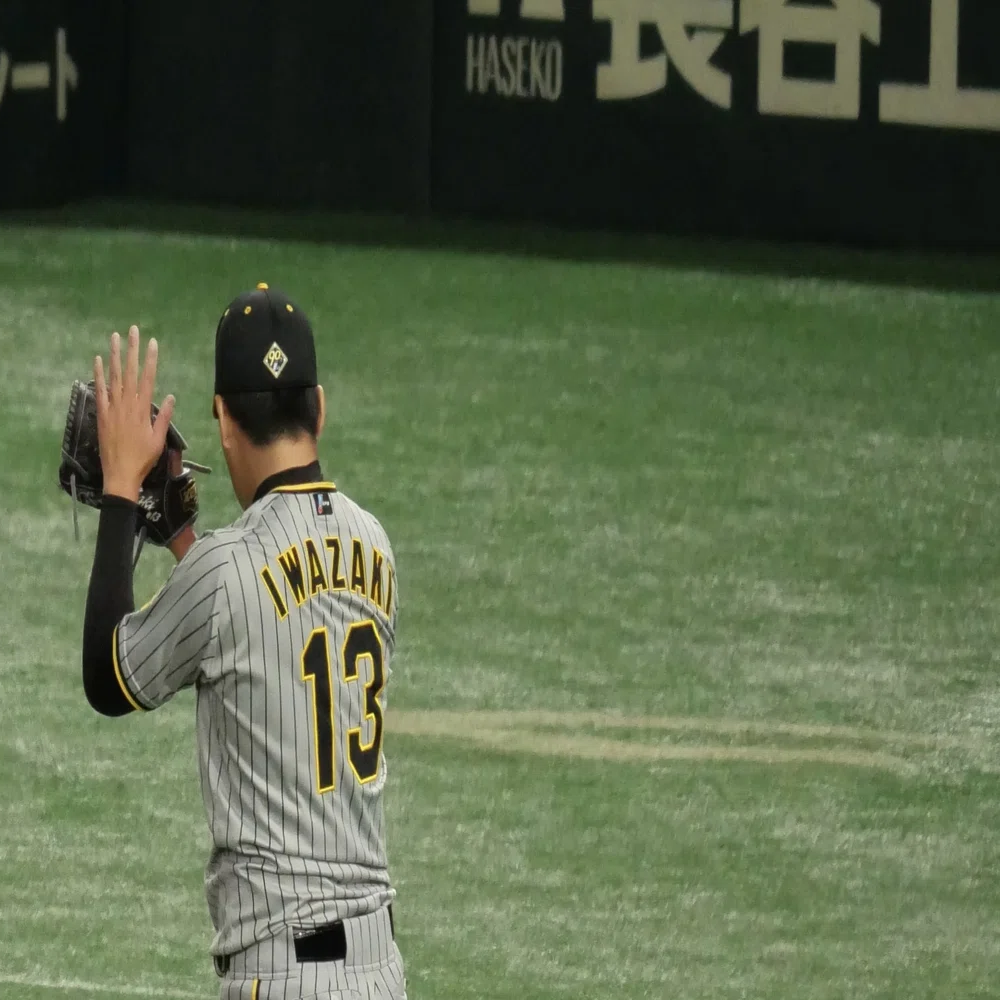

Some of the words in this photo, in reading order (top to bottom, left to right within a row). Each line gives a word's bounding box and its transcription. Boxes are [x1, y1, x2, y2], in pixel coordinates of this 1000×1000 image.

[465, 34, 563, 102] HASEKO
[259, 535, 393, 622] IWAZAKI
[300, 619, 385, 795] 13
